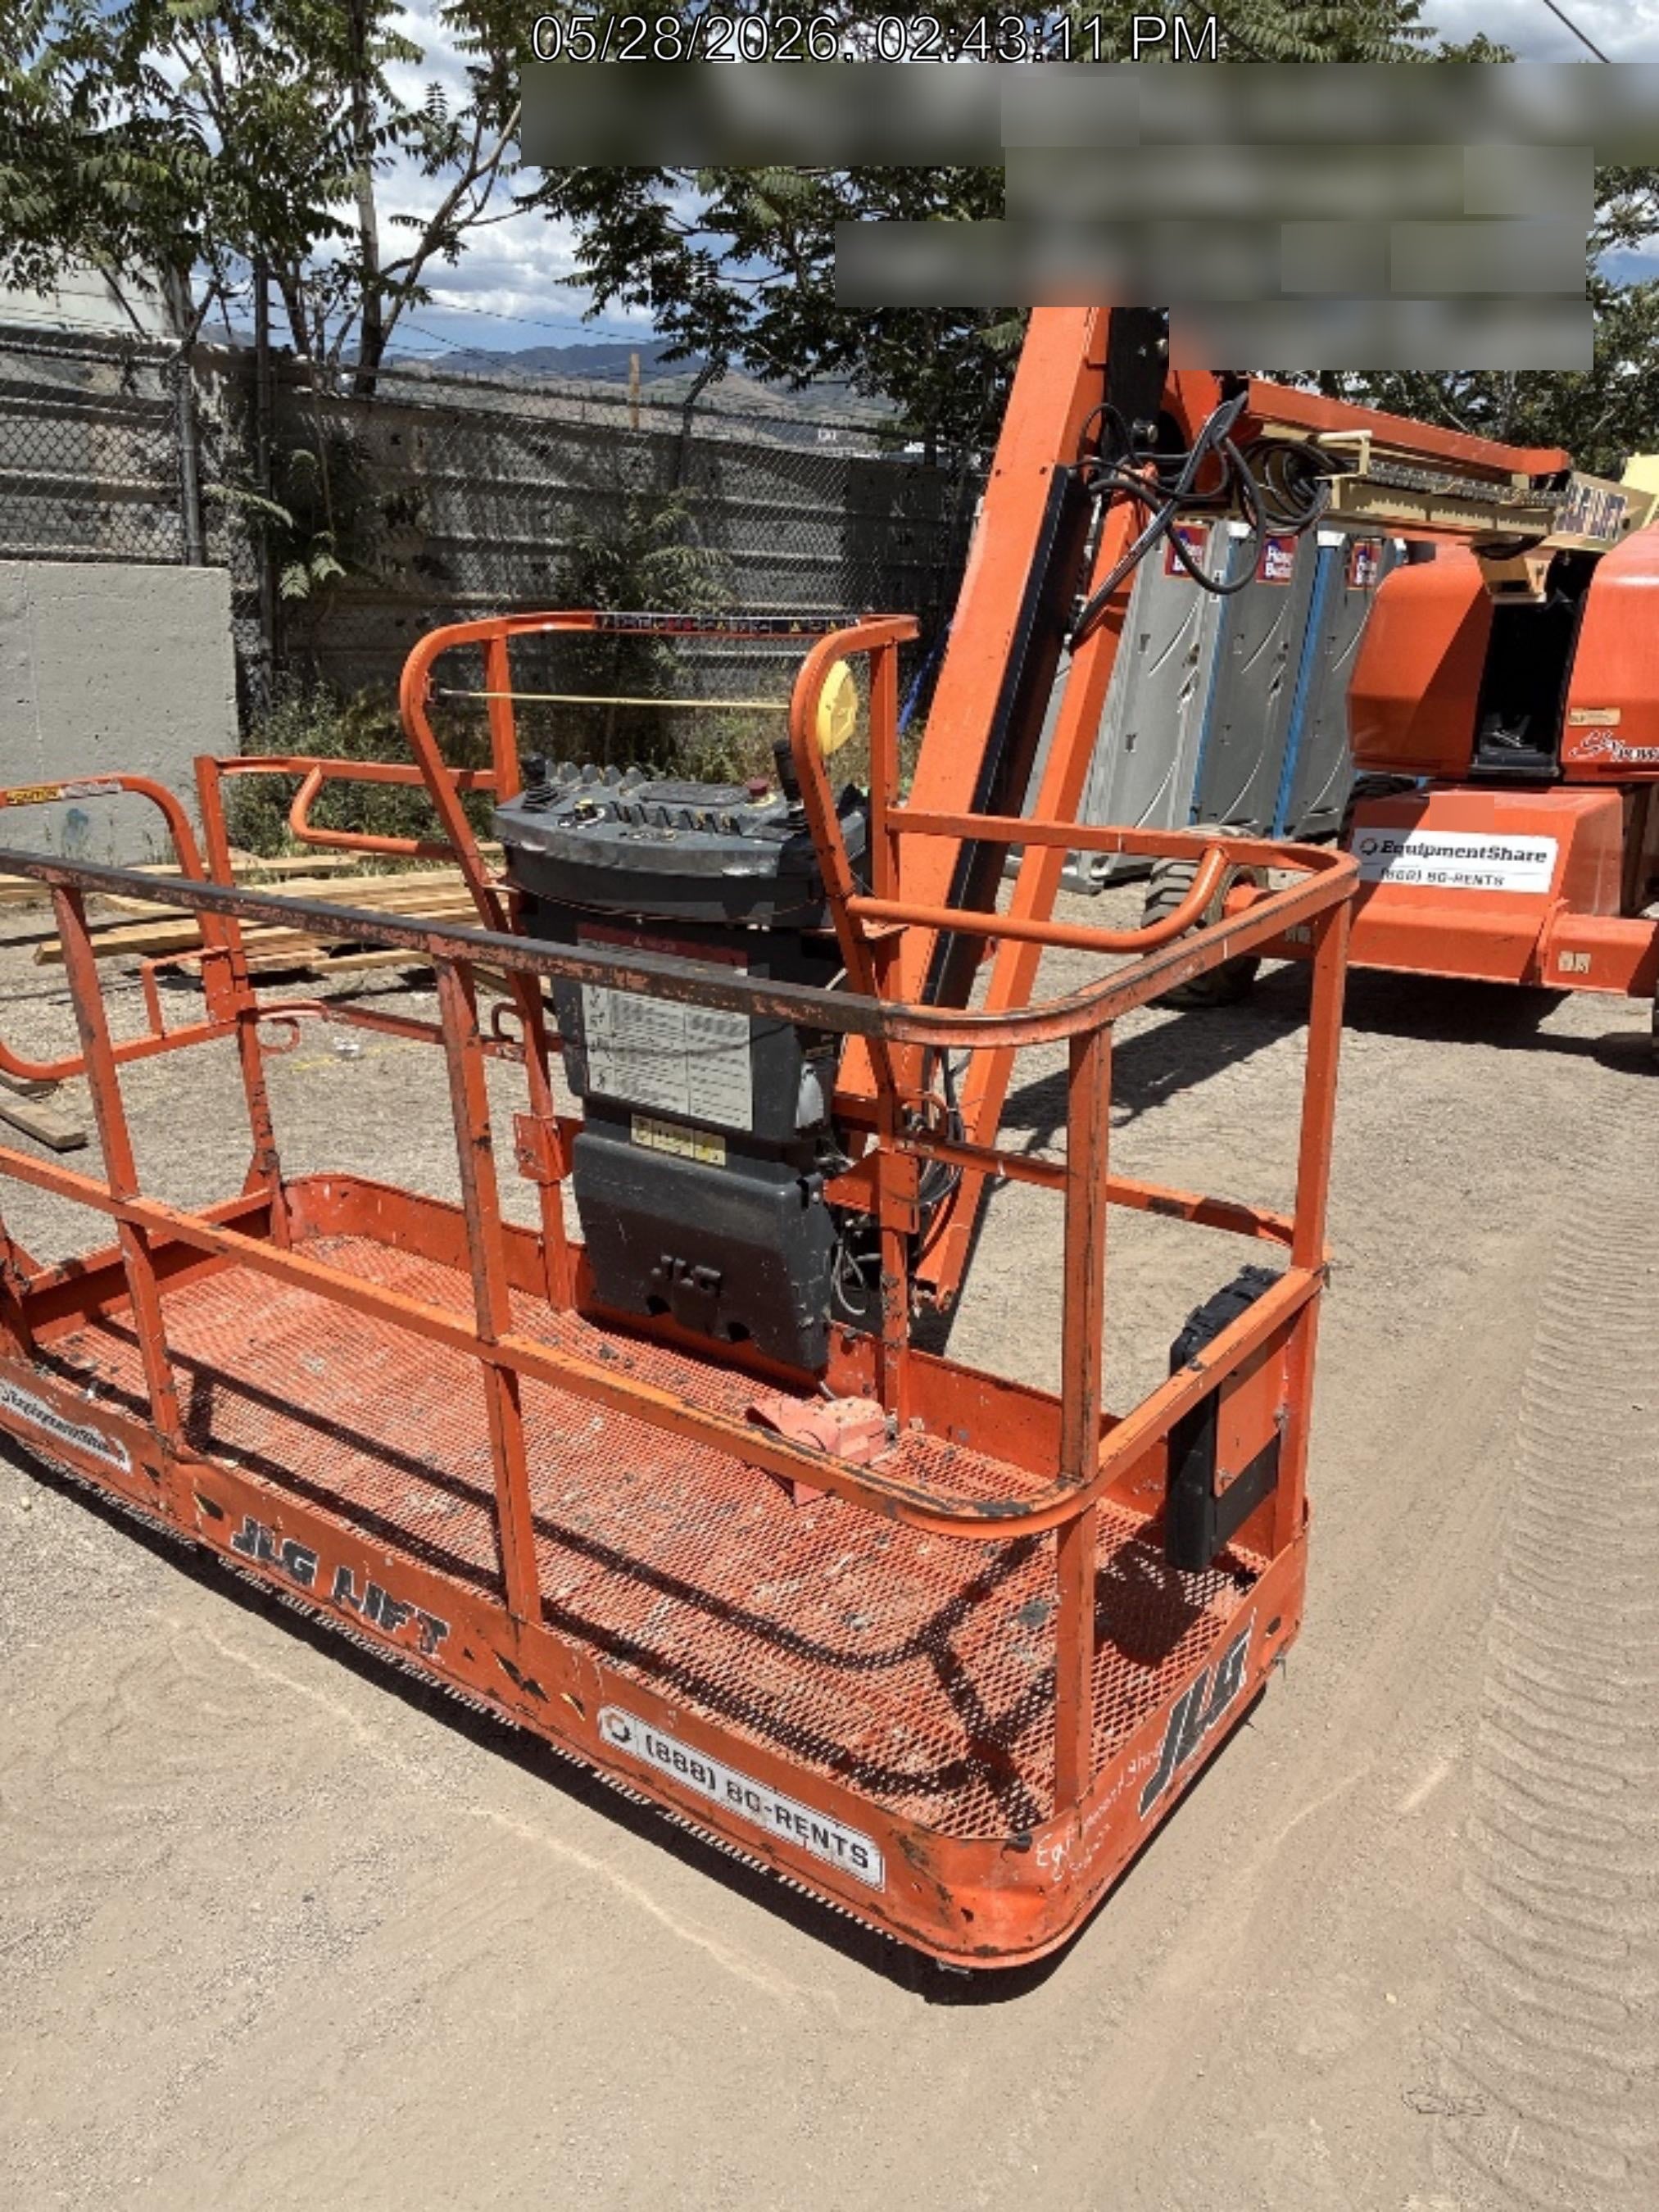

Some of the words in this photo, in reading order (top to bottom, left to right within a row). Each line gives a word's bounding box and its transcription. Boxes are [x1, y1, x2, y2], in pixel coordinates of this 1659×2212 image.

[1380, 840, 1548, 863] EquipmentShare
[231, 1514, 319, 1589] JLG
[331, 1566, 450, 1656] LIFT
[1138, 1625, 1249, 1821] JLG
[645, 1734, 716, 1791] (888)
[726, 1779, 869, 1870] 80-RENTS
